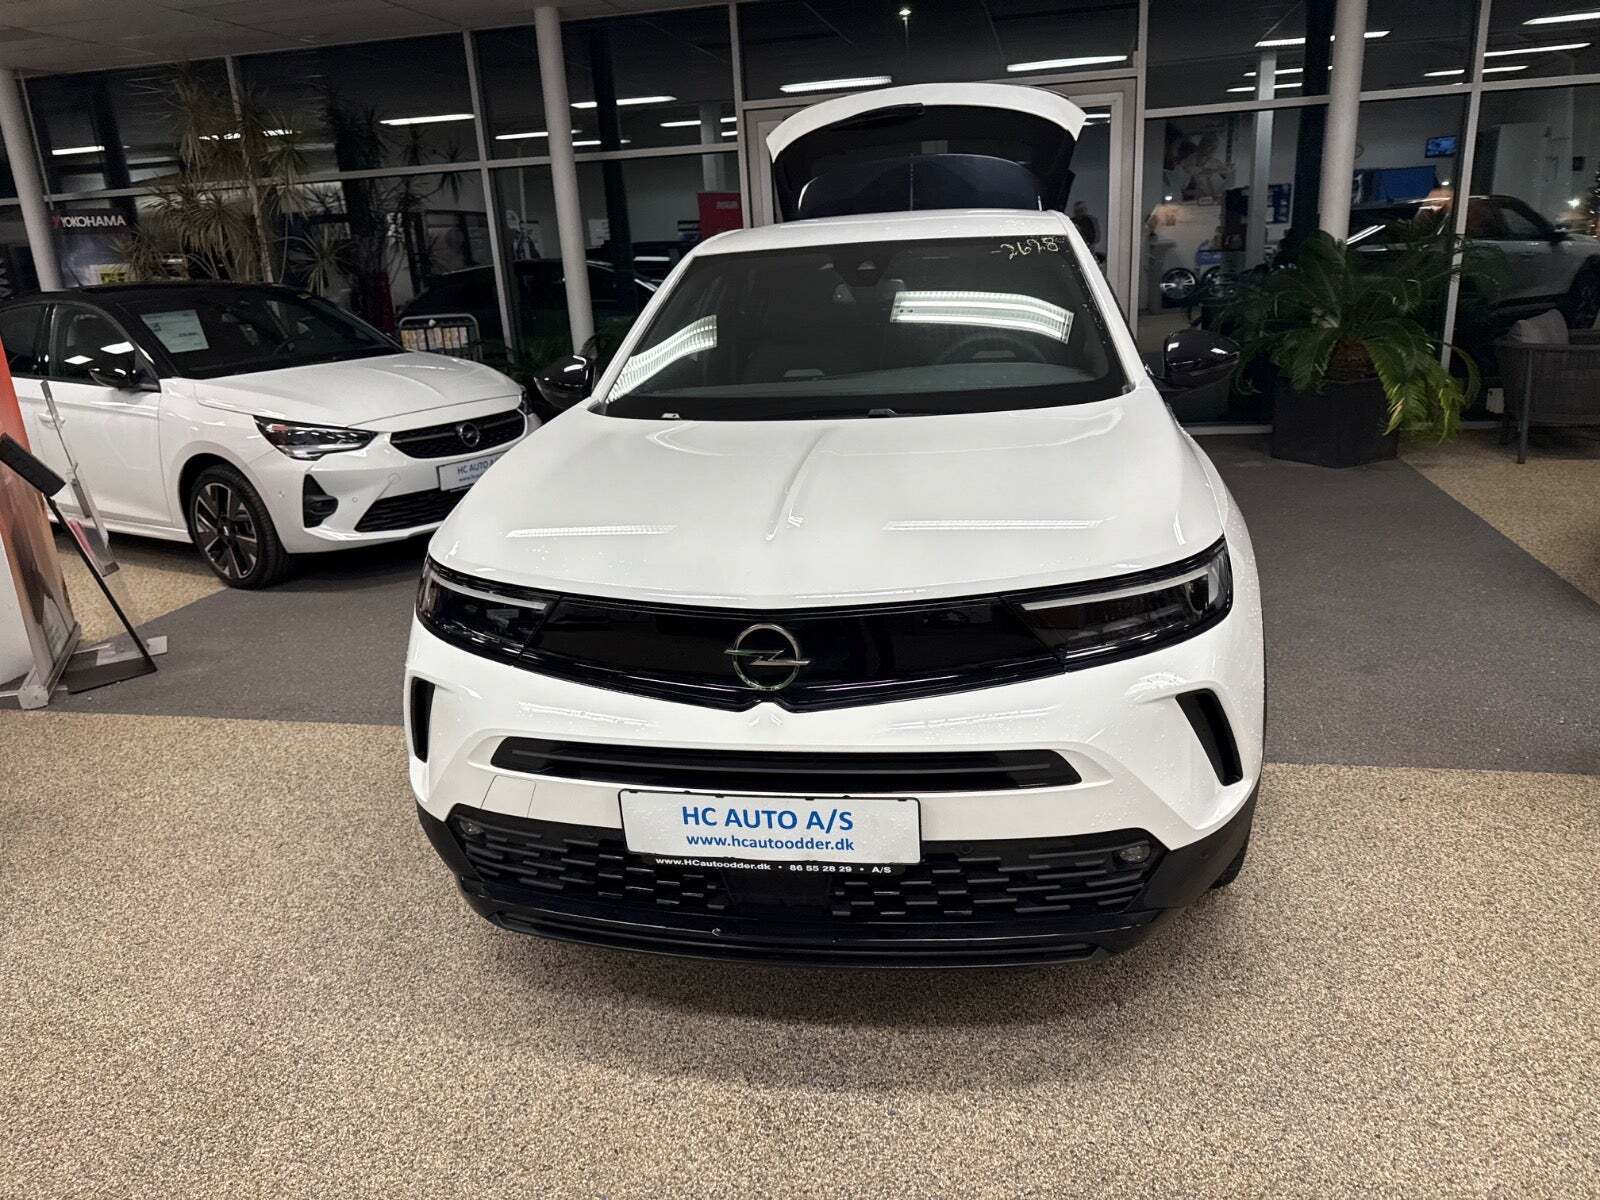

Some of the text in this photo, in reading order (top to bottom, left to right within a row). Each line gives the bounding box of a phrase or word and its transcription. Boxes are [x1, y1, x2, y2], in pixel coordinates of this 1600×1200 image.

[60, 215, 127, 228] YOKOHAMA
[469, 460, 488, 471] AUTO
[682, 806, 854, 834] HC AUTO A/S
[686, 834, 855, 851] www.hcautoodder.dk
[655, 857, 772, 871] www.HCautoodder.dk
[805, 864, 819, 873] 55
[822, 864, 836, 873] 28
[838, 865, 852, 874] 29
[871, 866, 892, 875] A/S
